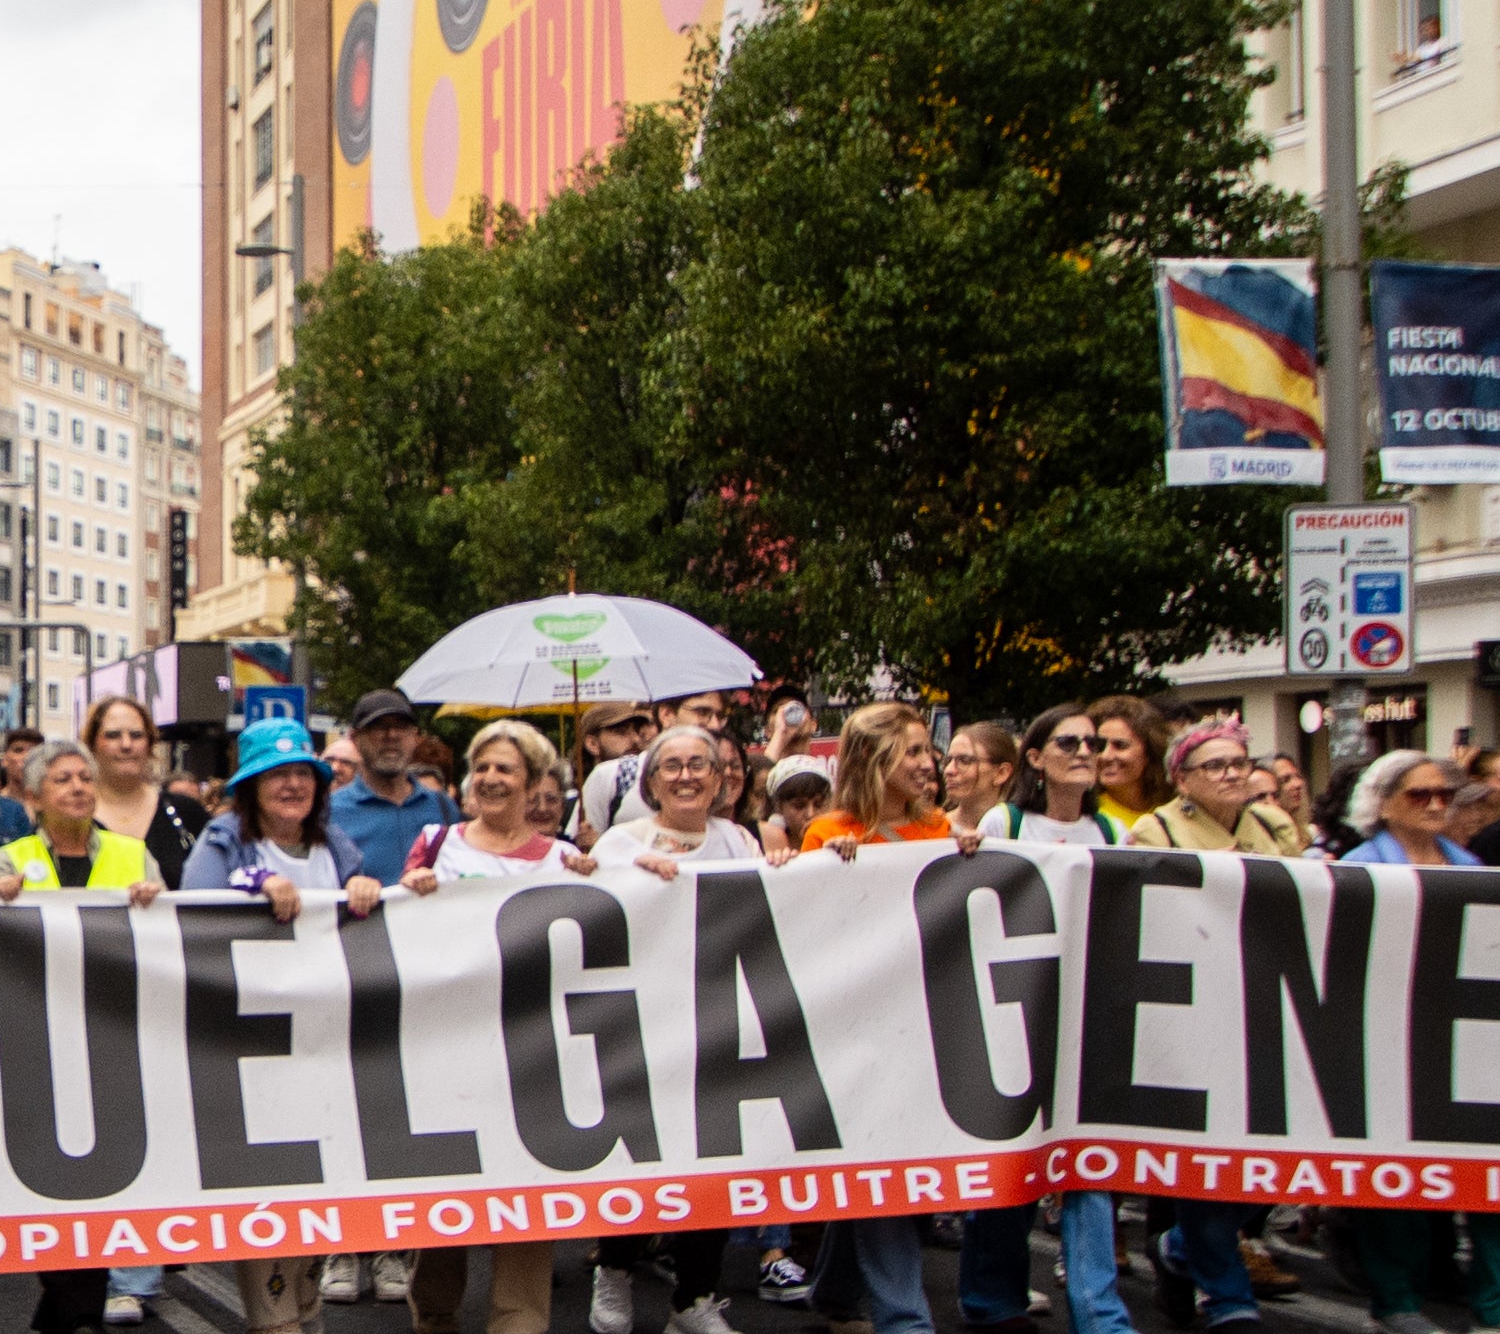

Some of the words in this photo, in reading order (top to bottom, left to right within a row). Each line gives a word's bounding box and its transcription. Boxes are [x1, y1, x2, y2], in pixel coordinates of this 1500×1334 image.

[1387, 326, 1464, 350] FIESTA
[1391, 409, 1422, 433] 12
[1231, 459, 1294, 480] MADRID
[1295, 511, 1405, 531] PRECAUCIÓN
[1302, 639, 1323, 659] 30
[380, 1182, 694, 1241] FONDOS
[727, 1160, 995, 1218] BUITRE
[1045, 1143, 1457, 1201] CONTRATOS
